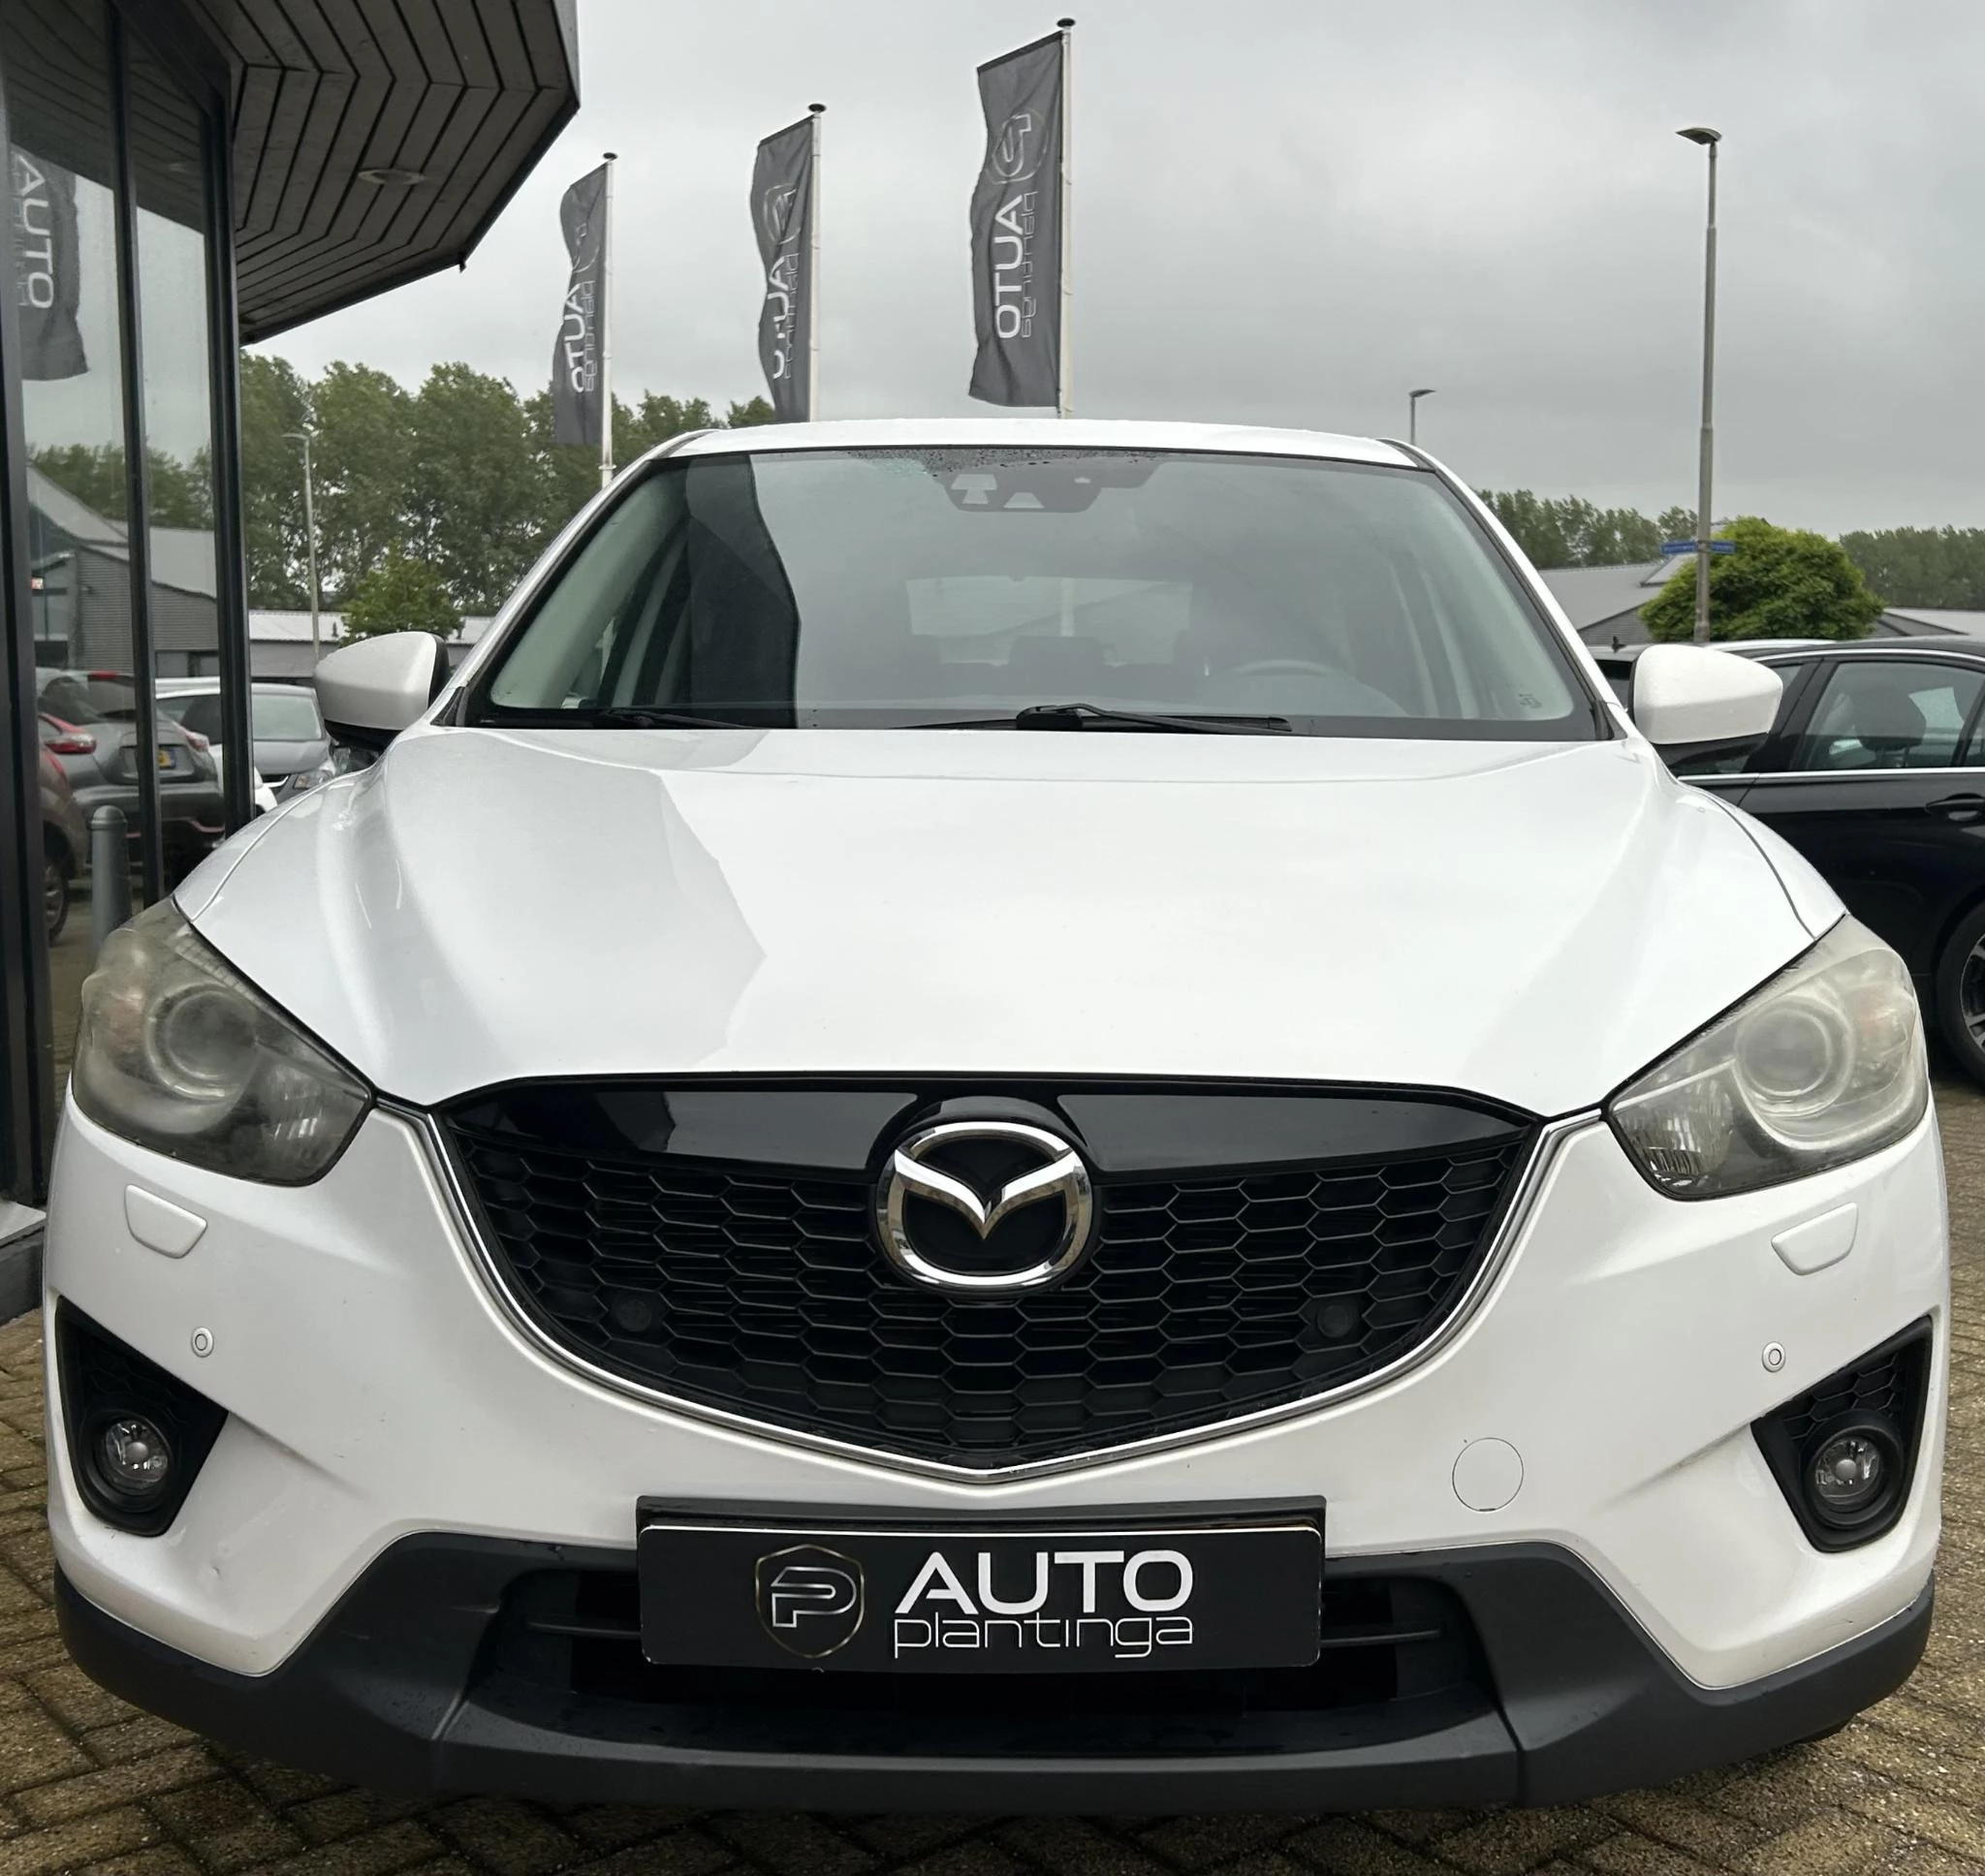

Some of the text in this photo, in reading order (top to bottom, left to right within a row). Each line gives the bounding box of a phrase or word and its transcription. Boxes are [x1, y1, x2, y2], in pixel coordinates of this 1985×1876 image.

[19, 155, 54, 308] AUTO
[894, 1549, 1194, 1615] AUTO
[894, 1610, 1194, 1659] plantinga
